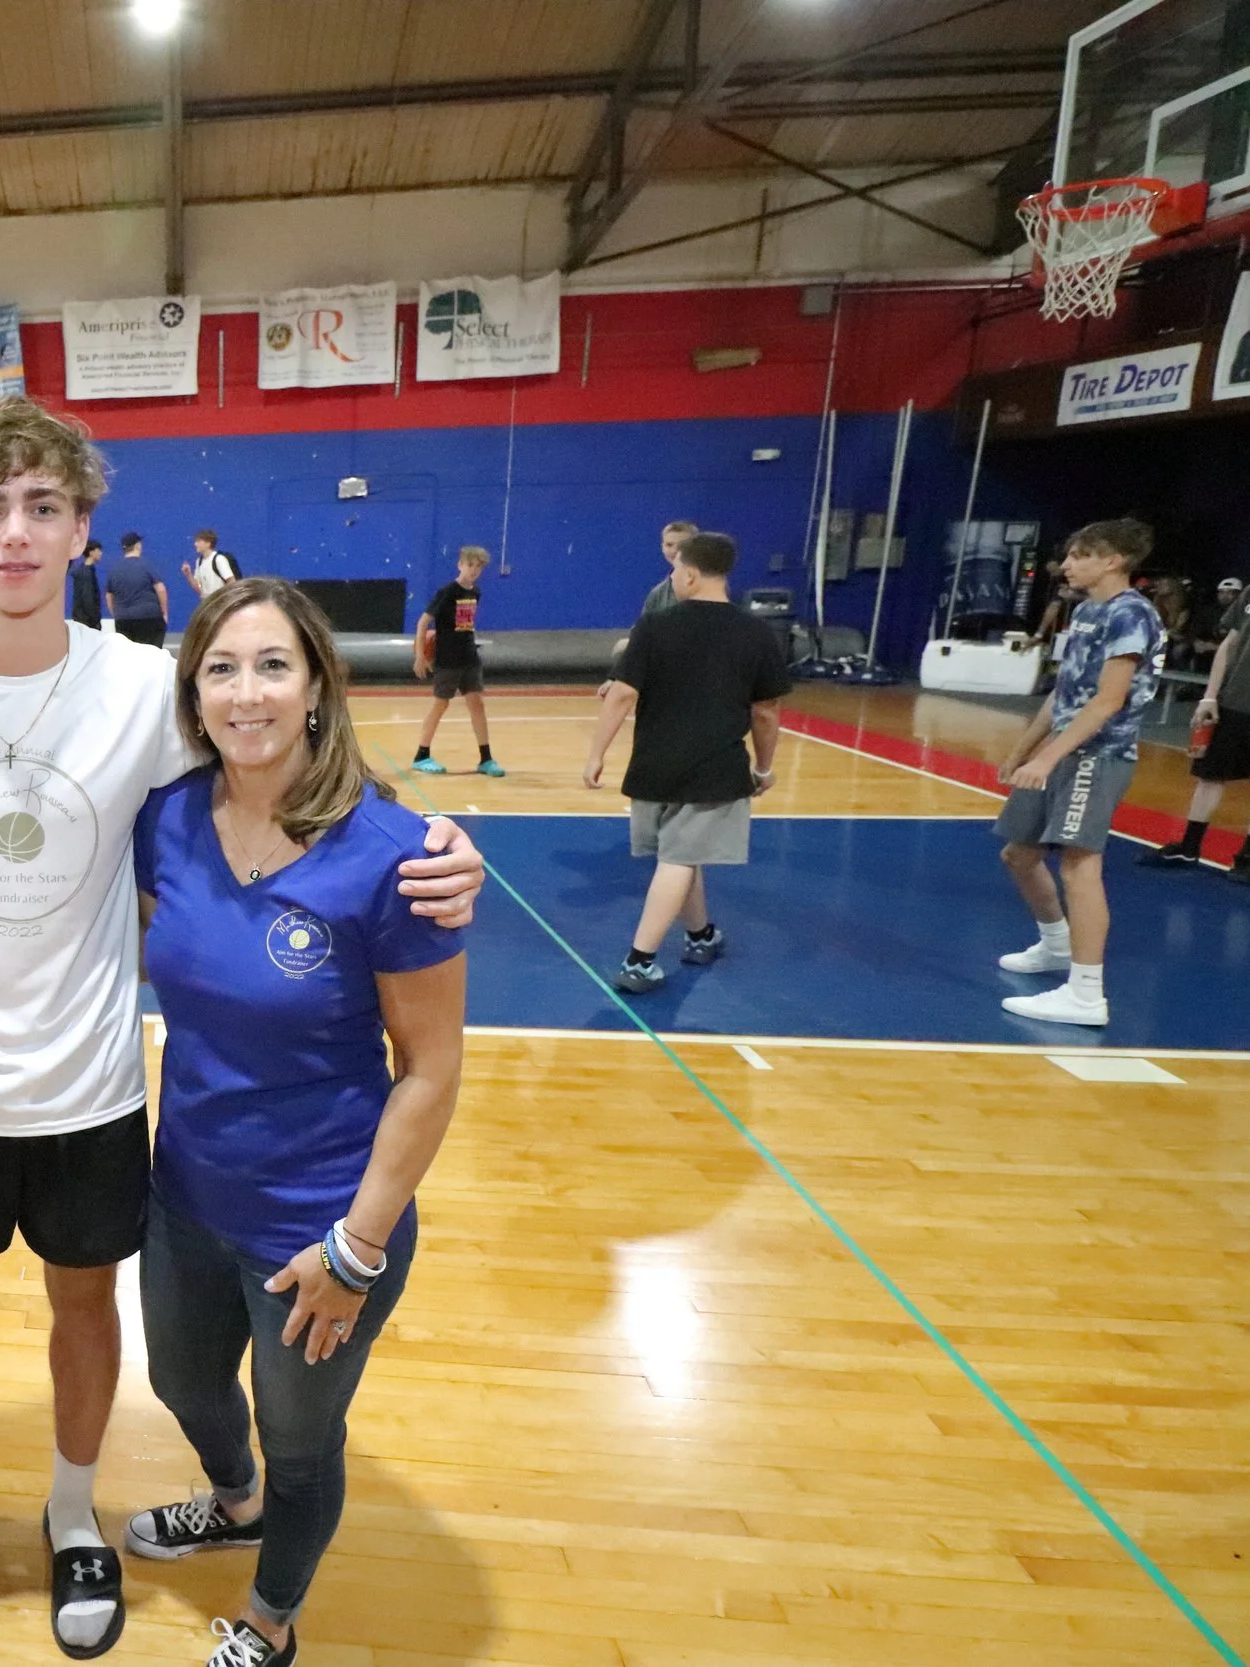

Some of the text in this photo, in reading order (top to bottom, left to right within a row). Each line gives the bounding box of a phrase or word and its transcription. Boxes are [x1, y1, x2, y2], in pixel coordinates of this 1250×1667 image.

[456, 313, 509, 337] Select
[117, 351, 146, 360] Wealth
[1059, 748, 1097, 840] OLLISTER
[14, 872, 34, 883] the
[38, 872, 67, 884] Stars
